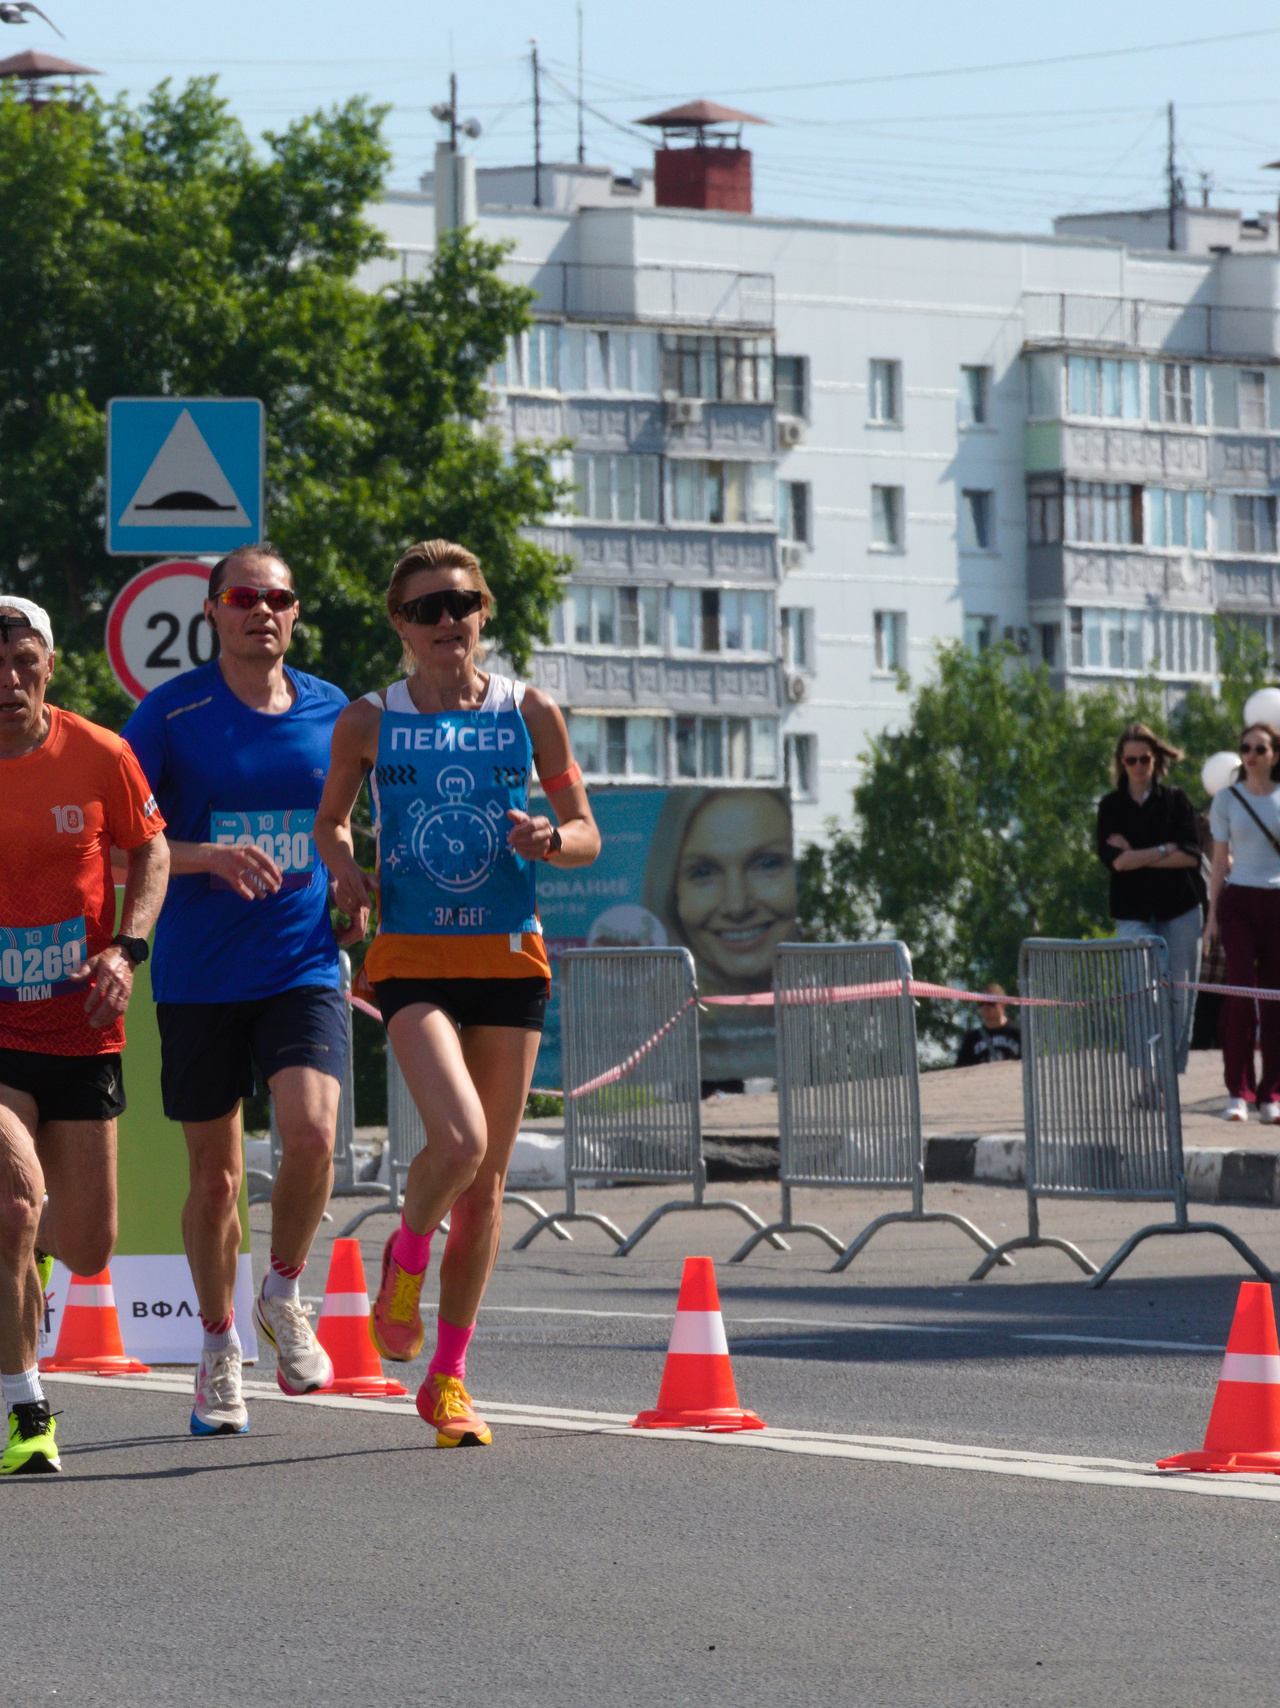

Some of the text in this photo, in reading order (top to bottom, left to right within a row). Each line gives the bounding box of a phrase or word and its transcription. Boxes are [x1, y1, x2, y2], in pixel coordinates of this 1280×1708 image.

[145, 611, 220, 669] 20
[391, 721, 516, 752] ПЕЙСЕР
[51, 795, 85, 834] 10
[258, 814, 274, 831] 10
[536, 878, 631, 897] ОВАНИЕ
[24, 930, 42, 946] 10
[16, 983, 52, 1001] 10KM
[132, 1300, 202, 1318] ВФЛ
